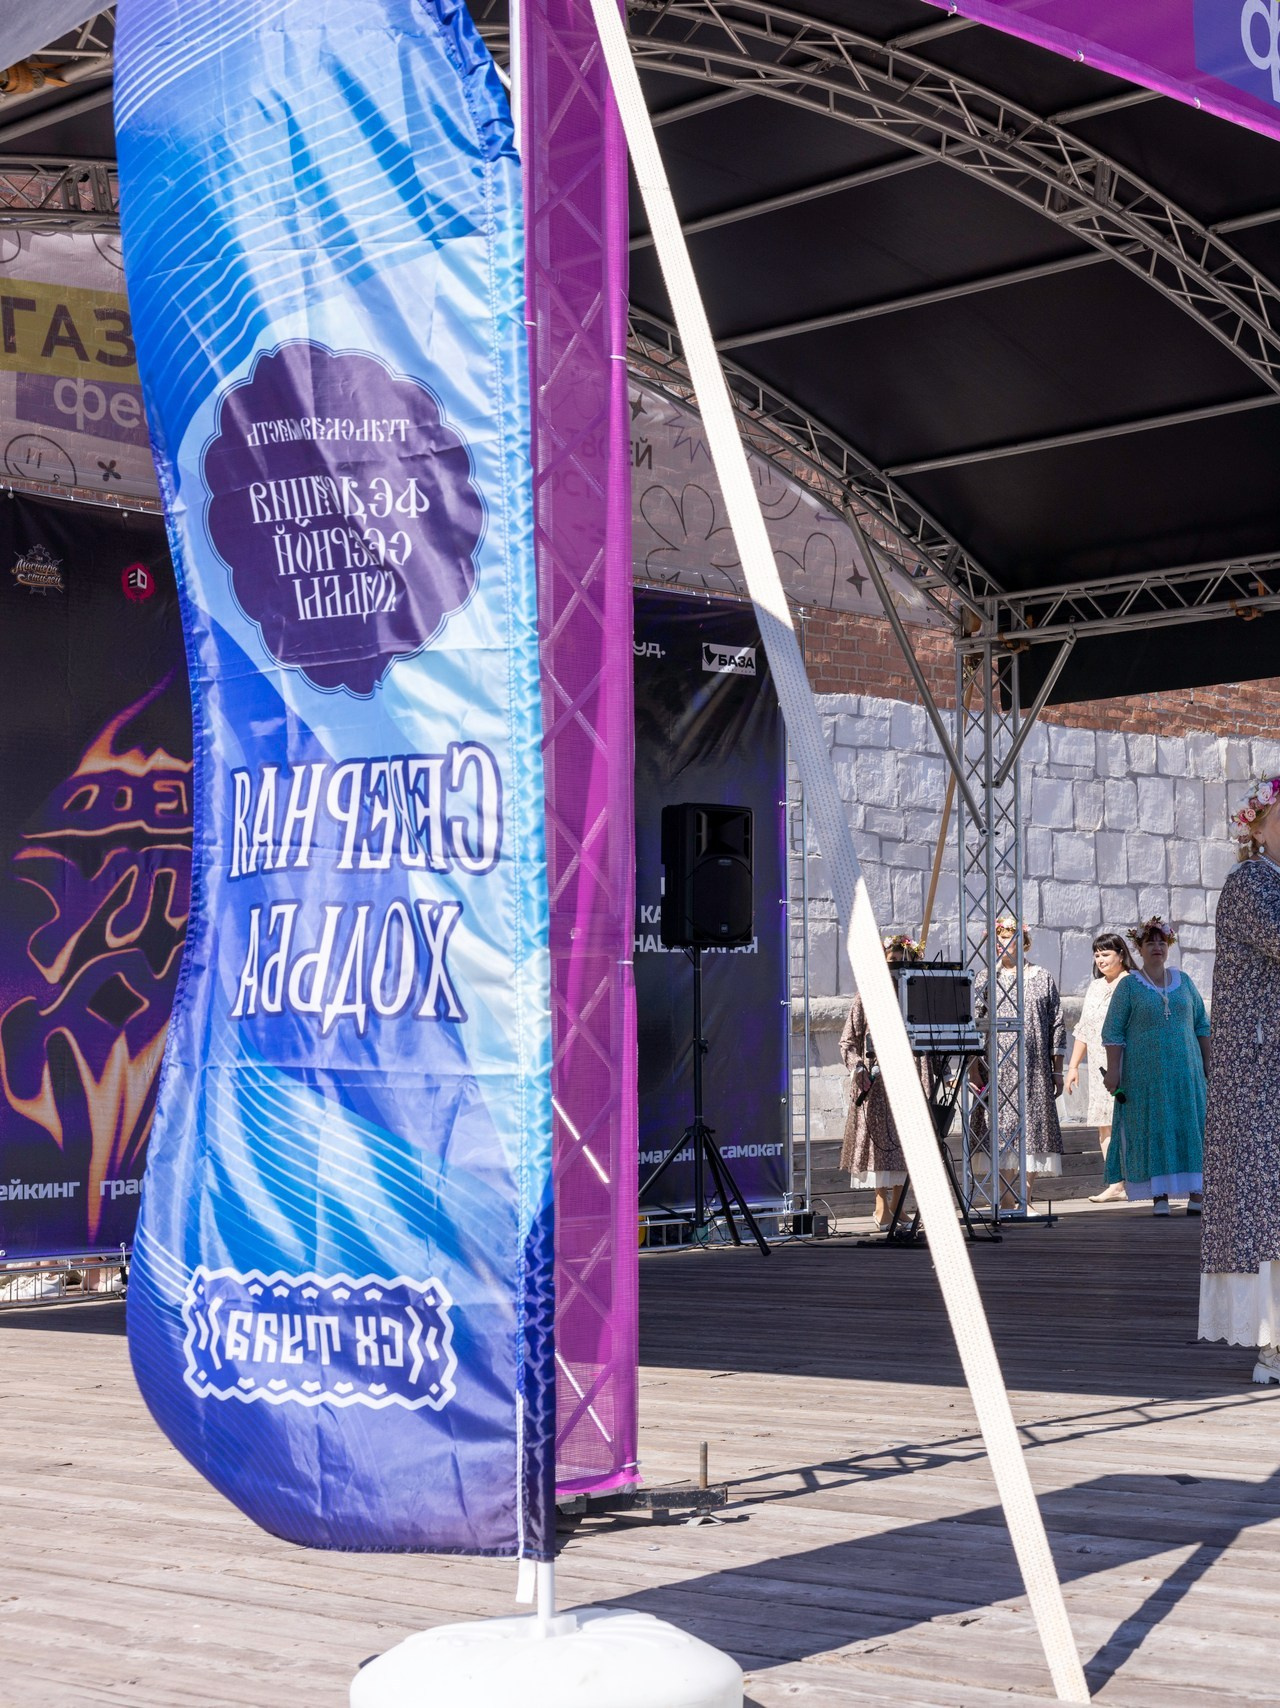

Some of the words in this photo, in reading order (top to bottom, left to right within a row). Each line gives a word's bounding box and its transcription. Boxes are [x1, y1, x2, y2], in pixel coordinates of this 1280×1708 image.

[53, 377, 148, 430] фе
[718, 654, 755, 669] БАЗА
[719, 1143, 784, 1160] самокат
[99, 1178, 145, 1200] гра
